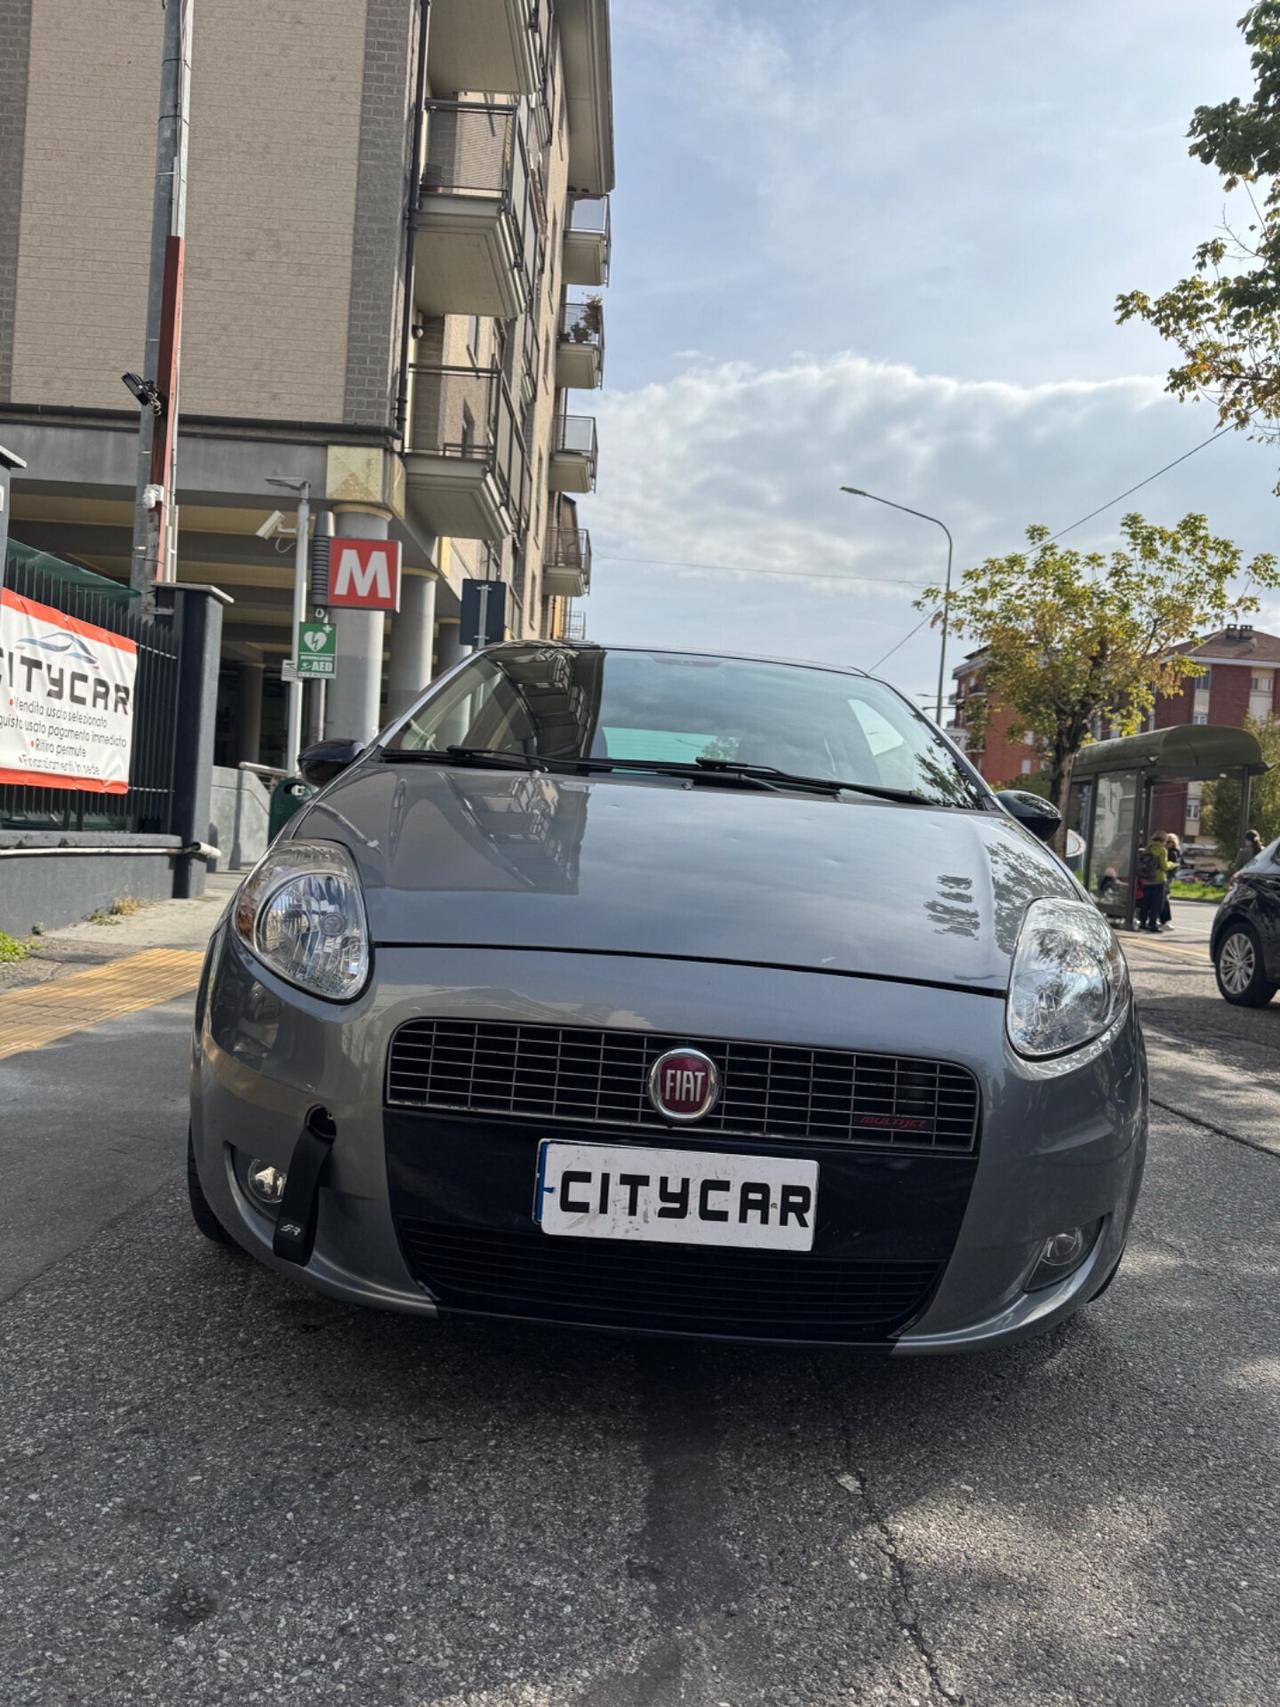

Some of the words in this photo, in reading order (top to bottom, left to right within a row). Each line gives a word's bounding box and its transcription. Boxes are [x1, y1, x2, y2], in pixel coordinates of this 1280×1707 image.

[333, 549, 391, 598] M
[0, 647, 130, 716] ITYCAR
[311, 661, 333, 672] AED
[14, 696, 44, 715] Vendita
[46, 706, 67, 721] usato
[67, 710, 108, 729] selezionato
[24, 718, 46, 734] usato
[48, 724, 90, 742] pagamento
[91, 731, 127, 749] immediato
[36, 738, 54, 753] Ritiro
[56, 744, 87, 759] permute
[665, 1069, 706, 1102] FIAT
[559, 1170, 812, 1228] CITYCAR
